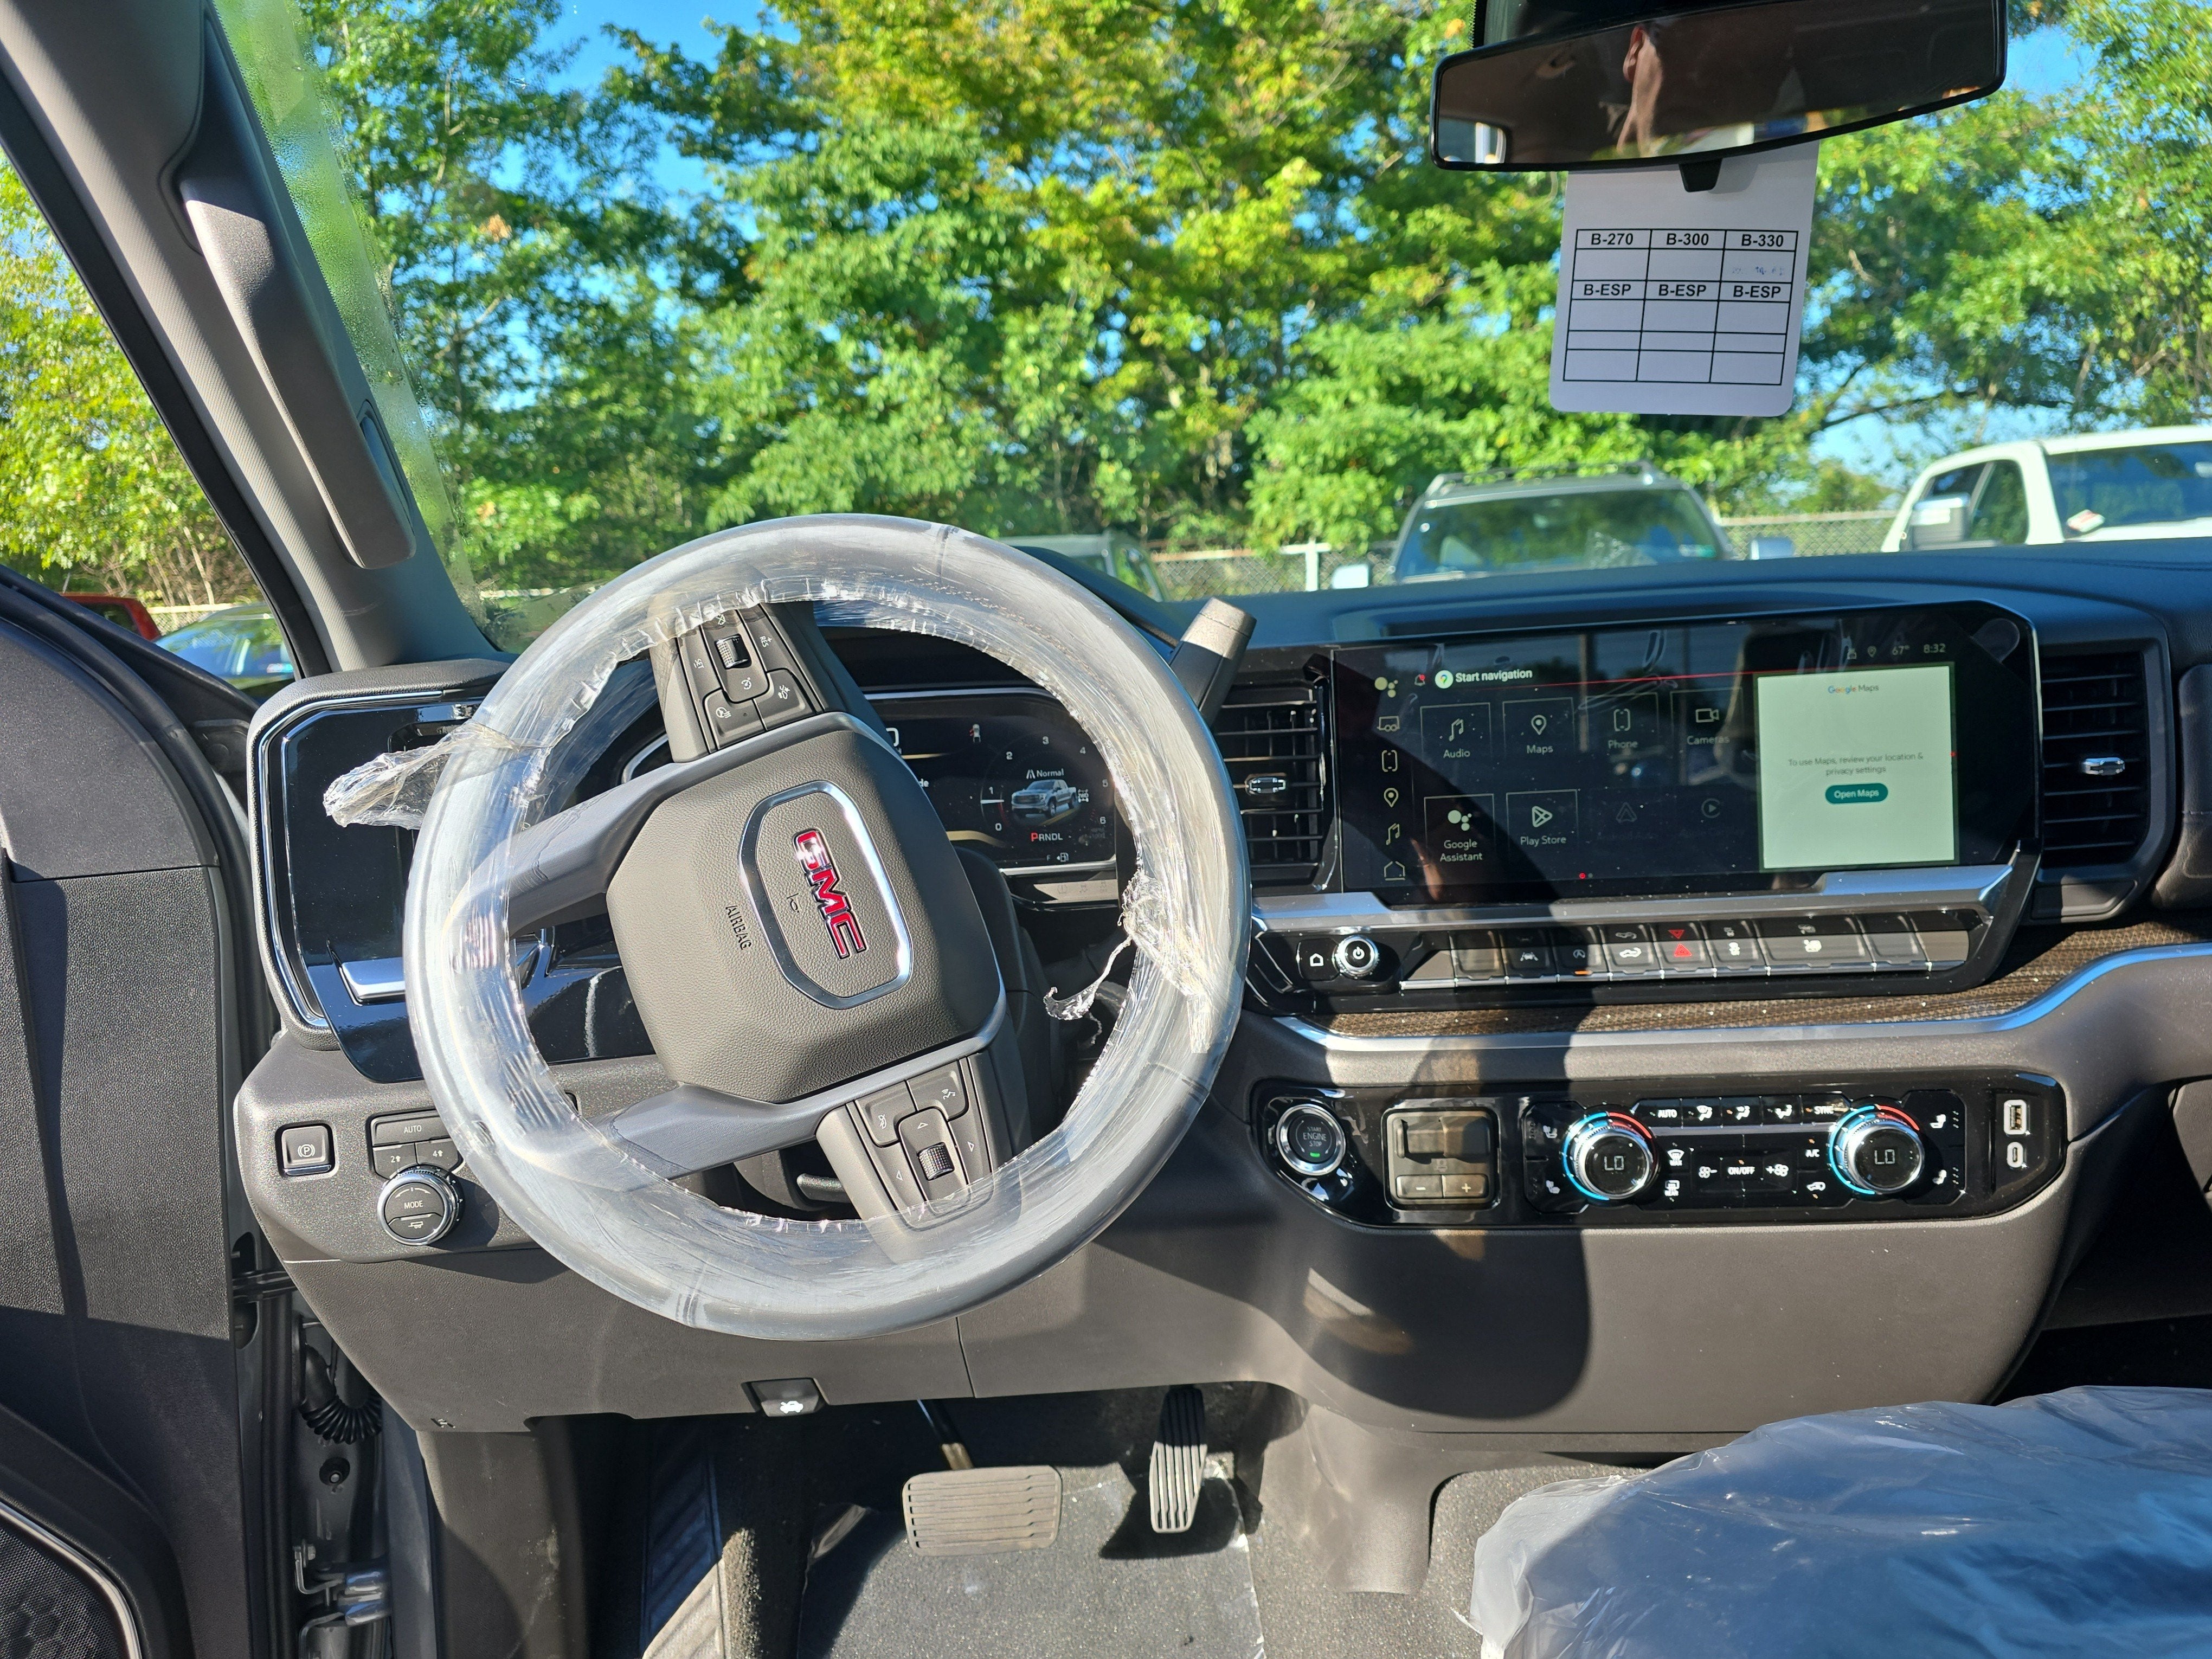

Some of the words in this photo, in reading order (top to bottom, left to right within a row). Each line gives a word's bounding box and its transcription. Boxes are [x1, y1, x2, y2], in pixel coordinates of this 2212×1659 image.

[1591, 233, 1634, 245] B-270
[1666, 233, 1709, 245] B-300
[1741, 234, 1784, 247] B-330
[1583, 284, 1631, 296] B-ESP
[1658, 284, 1707, 297] B-ESP
[1733, 285, 1781, 298] B-ESP
[760, 635, 769, 647] RES
[1924, 642, 1946, 653] 8:32
[694, 658, 704, 669] SET
[1455, 672, 1480, 683] Start
[1481, 669, 1533, 682] navigation
[1828, 685, 1857, 695] Google
[1858, 684, 1880, 693] Maps
[1043, 736, 1049, 745] 3
[1608, 740, 1638, 749] Phone
[1687, 735, 1731, 745] Cameras
[1443, 749, 1471, 758] Audio
[1526, 745, 1554, 755] Maps
[1006, 751, 1013, 760] 2
[1885, 754, 1915, 762] location
[1036, 768, 1064, 777] Normal
[1855, 766, 1887, 774] settings
[989, 786, 994, 795] 1
[1834, 790, 1856, 800] Open
[1857, 789, 1880, 799] Maps
[1099, 816, 1107, 825] 6
[995, 822, 1002, 831] 0
[1444, 839, 1477, 851] Google
[1520, 836, 1540, 847] Play
[1541, 835, 1566, 845] Store
[1440, 852, 1483, 862] Assistant
[793, 827, 867, 960] GMC
[725, 904, 753, 950] AIRBAG
[1657, 1109, 1678, 1118] AUTO
[1814, 1105, 1835, 1115] SYNC
[403, 1124, 422, 1134] AUTO
[1303, 1132, 1327, 1142] ENGINE
[1805, 1149, 1820, 1158] A/C
[1727, 1166, 1756, 1175] ON/OFF
[403, 1201, 424, 1210] MODE
